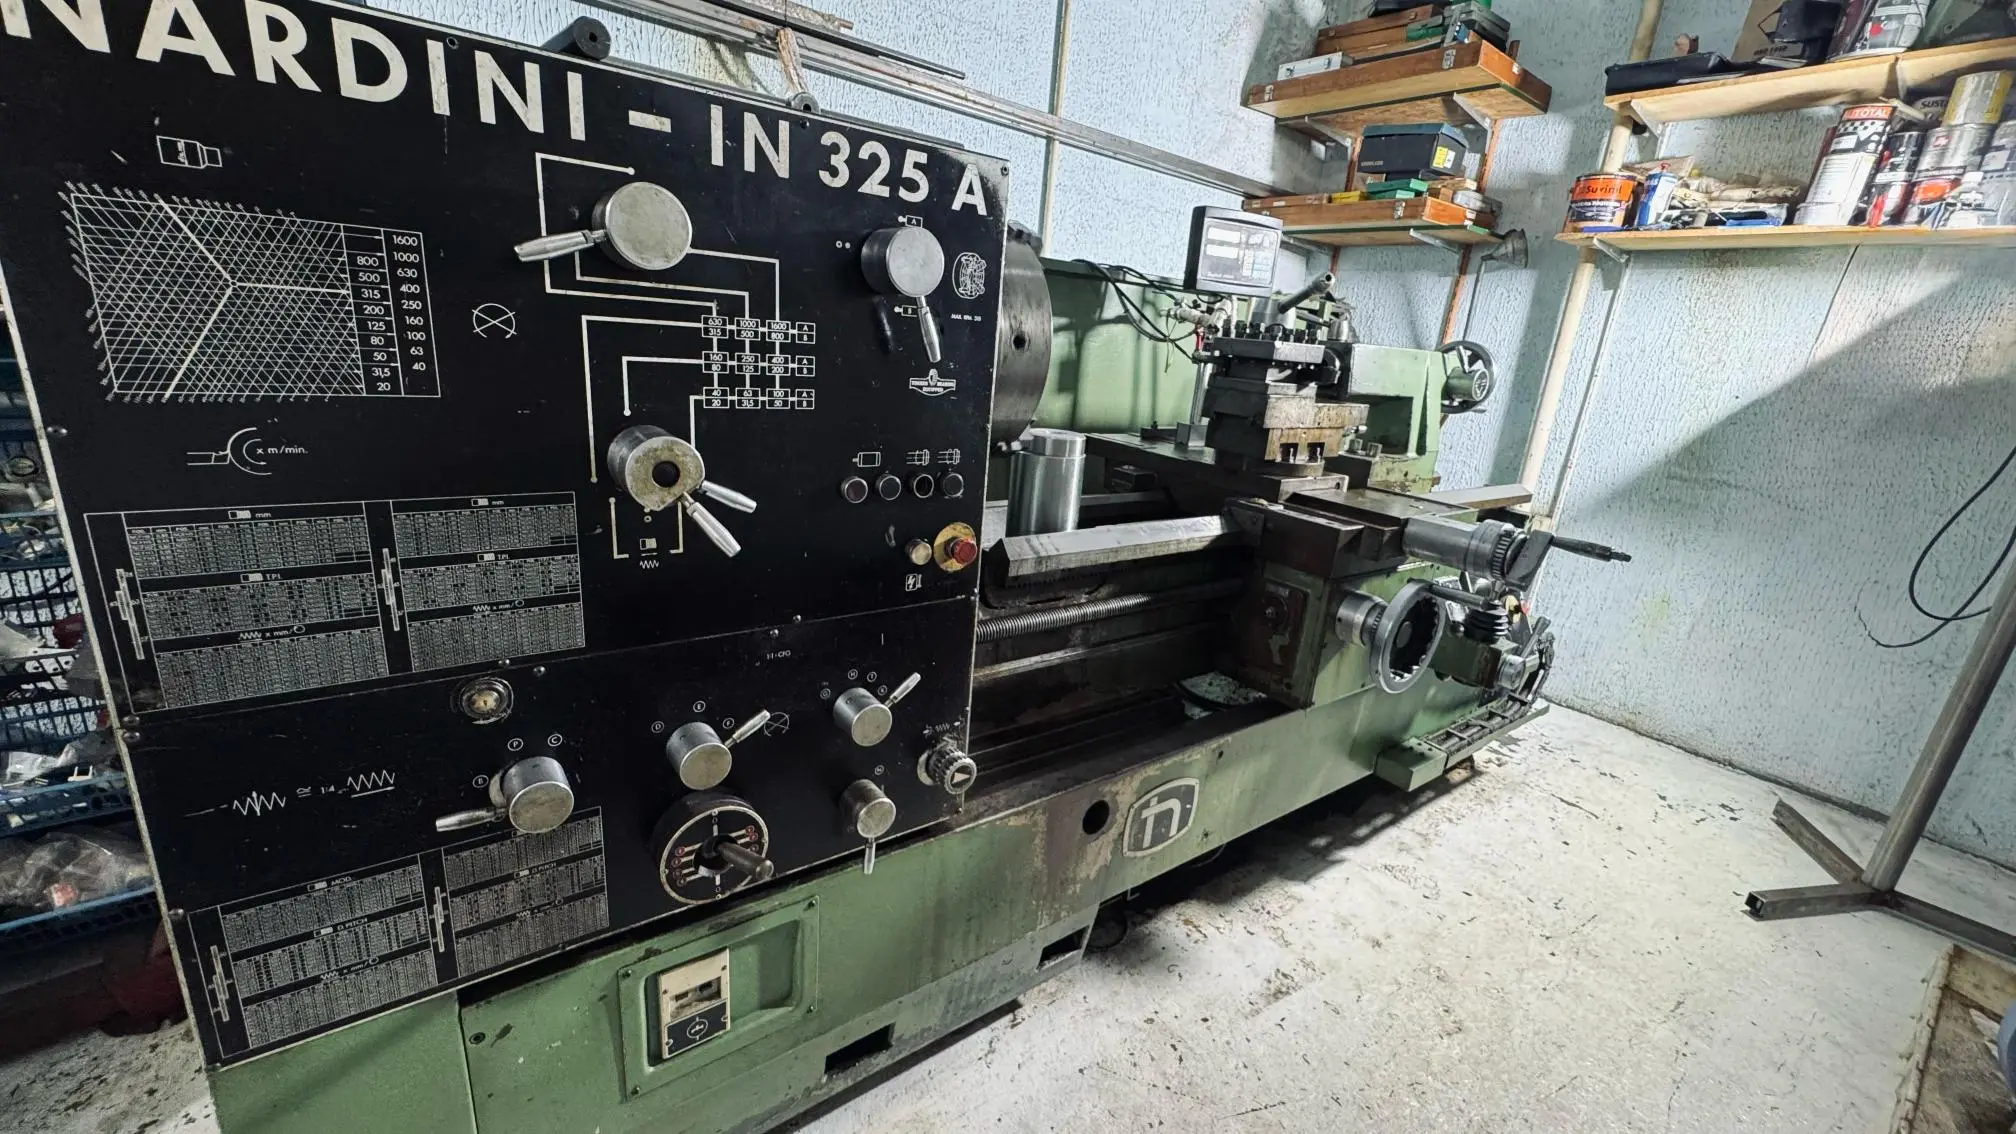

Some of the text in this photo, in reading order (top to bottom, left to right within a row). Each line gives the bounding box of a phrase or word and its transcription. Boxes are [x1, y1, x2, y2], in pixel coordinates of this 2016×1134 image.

[0, 0, 586, 141] NARDINI
[710, 104, 790, 179] IN
[818, 131, 930, 204] 325
[951, 163, 988, 217] A
[1854, 106, 1889, 119] TOTAL
[392, 234, 418, 247] 1600
[357, 256, 379, 267] 800
[393, 251, 419, 263] 1000
[358, 272, 380, 283] 500
[397, 268, 418, 278] 630
[361, 288, 381, 299] 315
[400, 283, 420, 294] 400
[363, 305, 384, 315] 200
[401, 300, 422, 310] 250
[405, 315, 423, 326] 160
[367, 321, 386, 331] 125
[407, 331, 426, 341] 100
[708, 328, 721, 336] 315
[370, 336, 384, 346] 80
[410, 346, 424, 356] 63
[373, 352, 387, 361] 50
[412, 362, 426, 371] 40
[742, 365, 754, 373] 125
[771, 366, 784, 374] 200
[376, 382, 391, 391] 20
[712, 399, 721, 407] 20
